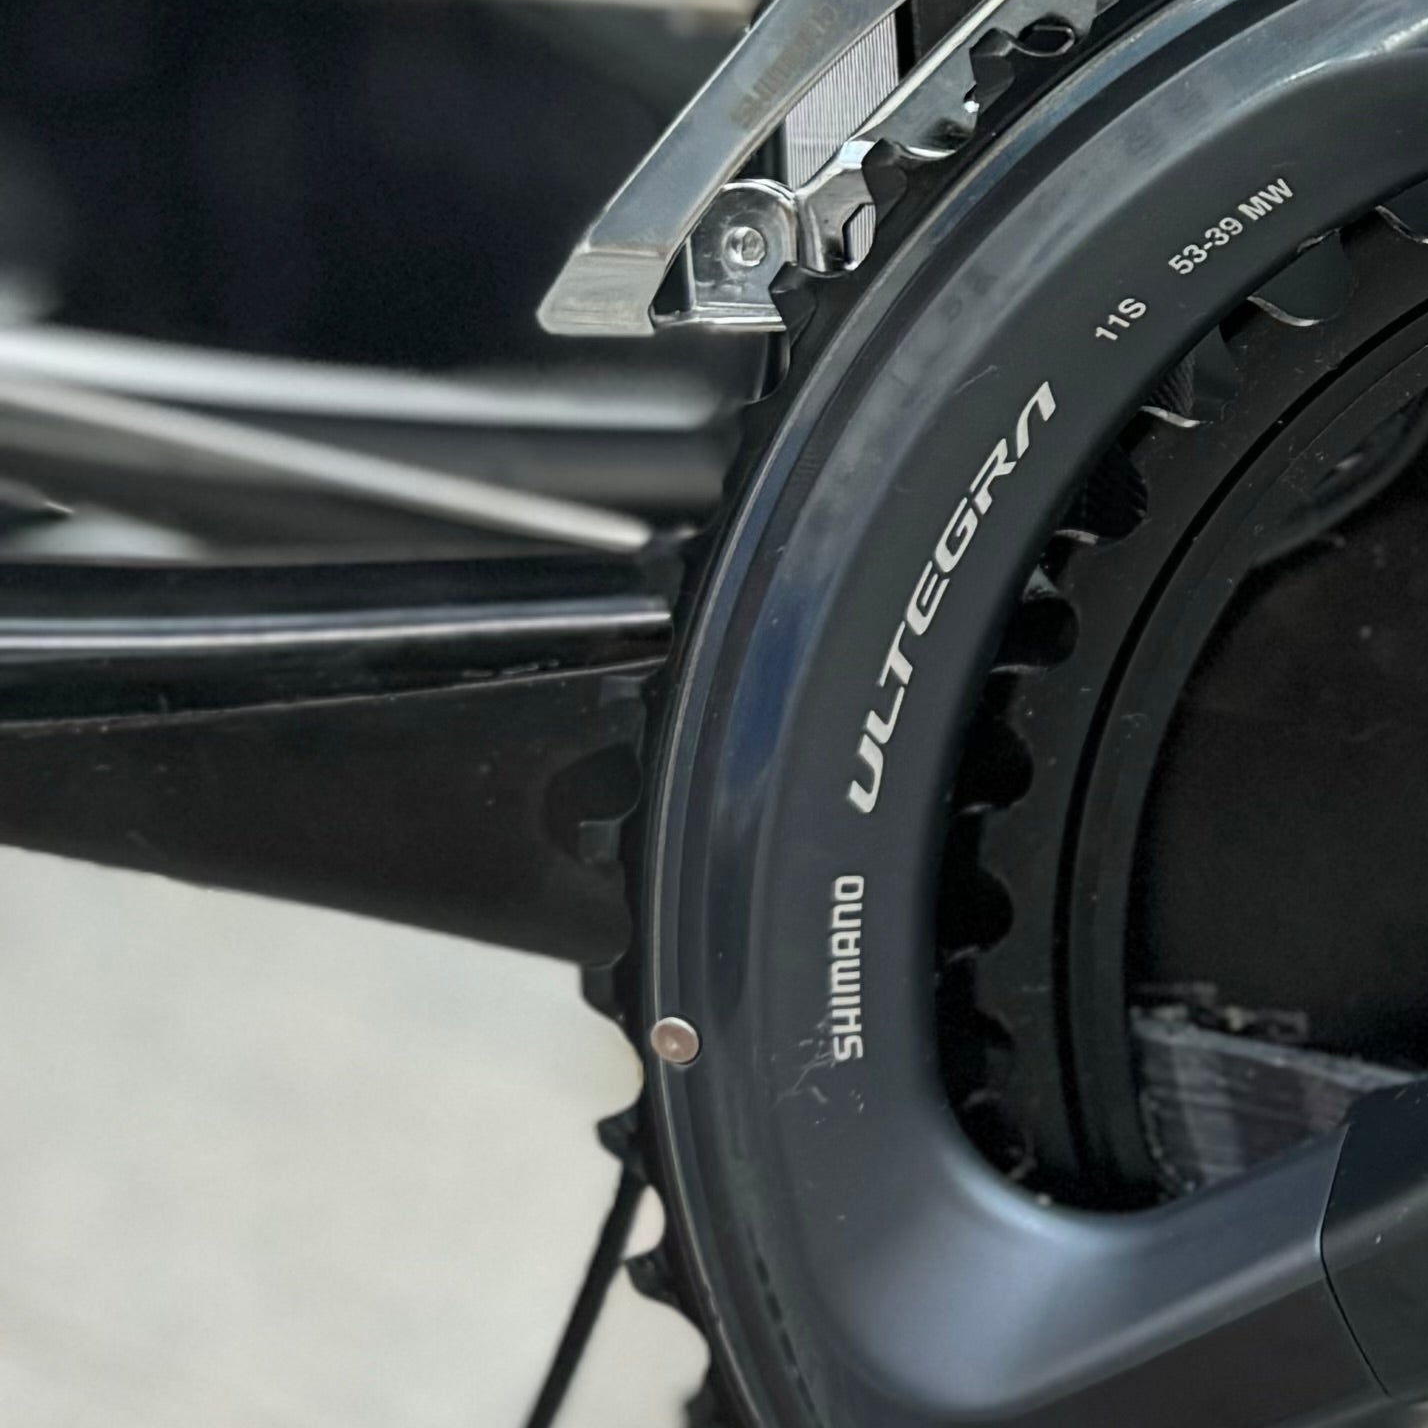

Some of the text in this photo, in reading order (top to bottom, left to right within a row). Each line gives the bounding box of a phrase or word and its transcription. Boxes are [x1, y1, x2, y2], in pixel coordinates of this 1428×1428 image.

[1095, 178, 1293, 341] 11S 53-39 MW
[845, 381, 1057, 813] ULTEGRA
[832, 875, 865, 1061] SHIMANO
